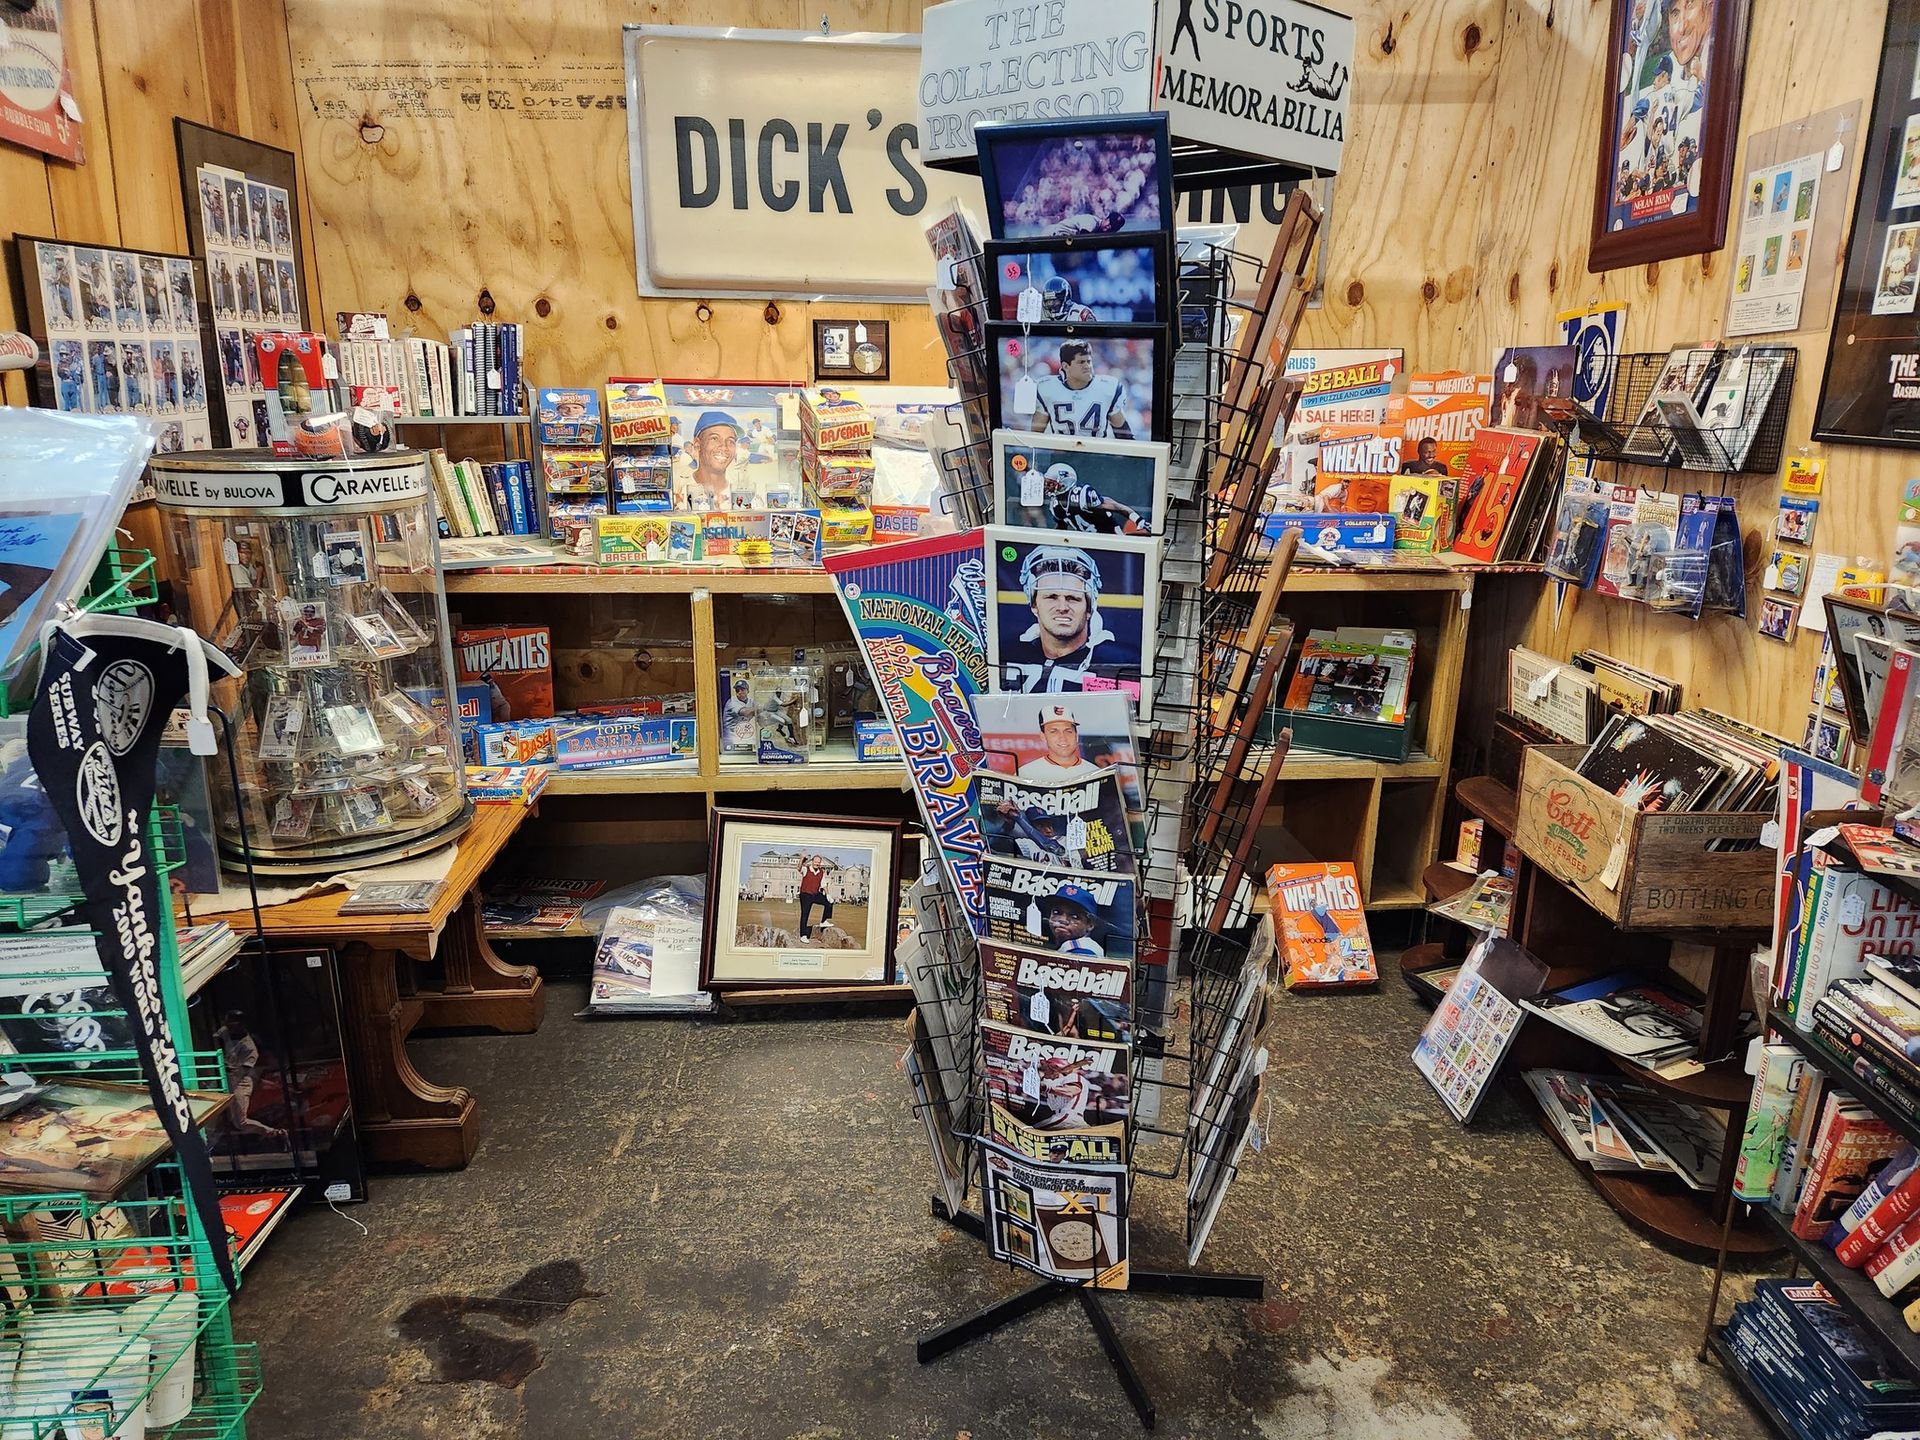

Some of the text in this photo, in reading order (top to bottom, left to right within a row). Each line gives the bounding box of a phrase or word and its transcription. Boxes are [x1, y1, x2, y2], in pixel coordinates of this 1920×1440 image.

[985, 0, 1066, 51] THE
[1203, 0, 1325, 65] SPORTS
[919, 30, 1150, 108] COLLECTING
[1159, 66, 1345, 142] MEMORABILIA
[674, 108, 928, 215] DICK'S
[1633, 193, 1671, 211] NOLAN RYAN
[1009, 344, 1018, 353] 35
[1287, 357, 1316, 370] RUSS
[1889, 354, 1920, 383] THE
[420, 374, 429, 399] BASEBALL
[1320, 394, 1344, 403] PUZZLE
[1344, 391, 1359, 399] AND
[1360, 388, 1381, 397] CARDS
[1435, 376, 1476, 394] WHEATIES
[816, 404, 863, 415] BASEBALL
[1054, 403, 1100, 437] 54
[1307, 409, 1374, 422] SALE HERE!
[612, 418, 667, 439] BASEBALL
[820, 423, 870, 444] BASEBALL
[1405, 407, 1485, 442] WHEATIES
[1321, 436, 1402, 474] WHEATIES
[205, 487, 219, 498] by
[224, 486, 275, 498] BULOVA
[310, 474, 410, 503] CARAVELLE
[1460, 472, 1517, 548] 15
[635, 520, 667, 537] BOWMAN
[874, 515, 918, 530] BASEB
[859, 599, 944, 638] NATIONAL
[290, 654, 328, 664] JOHN ELWAY
[463, 632, 549, 672] WHEATIES
[886, 634, 915, 679] 1992
[866, 637, 911, 722] ATLANTA
[48, 682, 70, 749] SERIES
[59, 672, 85, 751] SUBWAY
[595, 723, 641, 736] TOPPS
[567, 729, 670, 753] BASEBALL
[597, 747, 643, 759] CARDS
[981, 778, 1001, 789] Street
[981, 786, 993, 795] and
[1003, 780, 1101, 816] Baseball
[900, 715, 988, 916] BRAVES
[1087, 818, 1103, 829] THE
[1547, 788, 1597, 839] Cott
[1674, 816, 1734, 825] DISTRIBUTOR
[1086, 826, 1108, 840] TALK
[1658, 826, 1742, 834] TWO WEEKS PLEASE
[1543, 836, 1588, 875] BEVERAGES
[988, 871, 1001, 879] and
[990, 863, 1012, 875] Street
[986, 877, 1012, 888] Smith's
[1011, 868, 1119, 906] Baseball
[1282, 875, 1360, 912] WHEATIES
[1647, 888, 1748, 910] BOTTLING
[110, 838, 161, 1015] Yankees
[1340, 938, 1353, 957] 2
[1803, 875, 1836, 1011] Bill Bradley LIFE ON THE RUN
[113, 901, 137, 960] 2000
[129, 962, 154, 1036] WORLD
[617, 949, 643, 968] LUCAS
[1017, 958, 1127, 997] Baseball
[1816, 1004, 1827, 1015] RED
[1834, 990, 1865, 1018] SEASON
[1813, 1011, 1827, 1024] JOHN
[1007, 1034, 1117, 1074] Baseball
[1875, 1076, 1916, 1112] BILL RUSSELL
[1836, 1147, 1897, 1161] White
[1011, 1165, 1076, 1186] MASTERPIECES
[1012, 1173, 1112, 1195] UNCOMMON COMMONS
[1867, 1216, 1886, 1237] PETE
